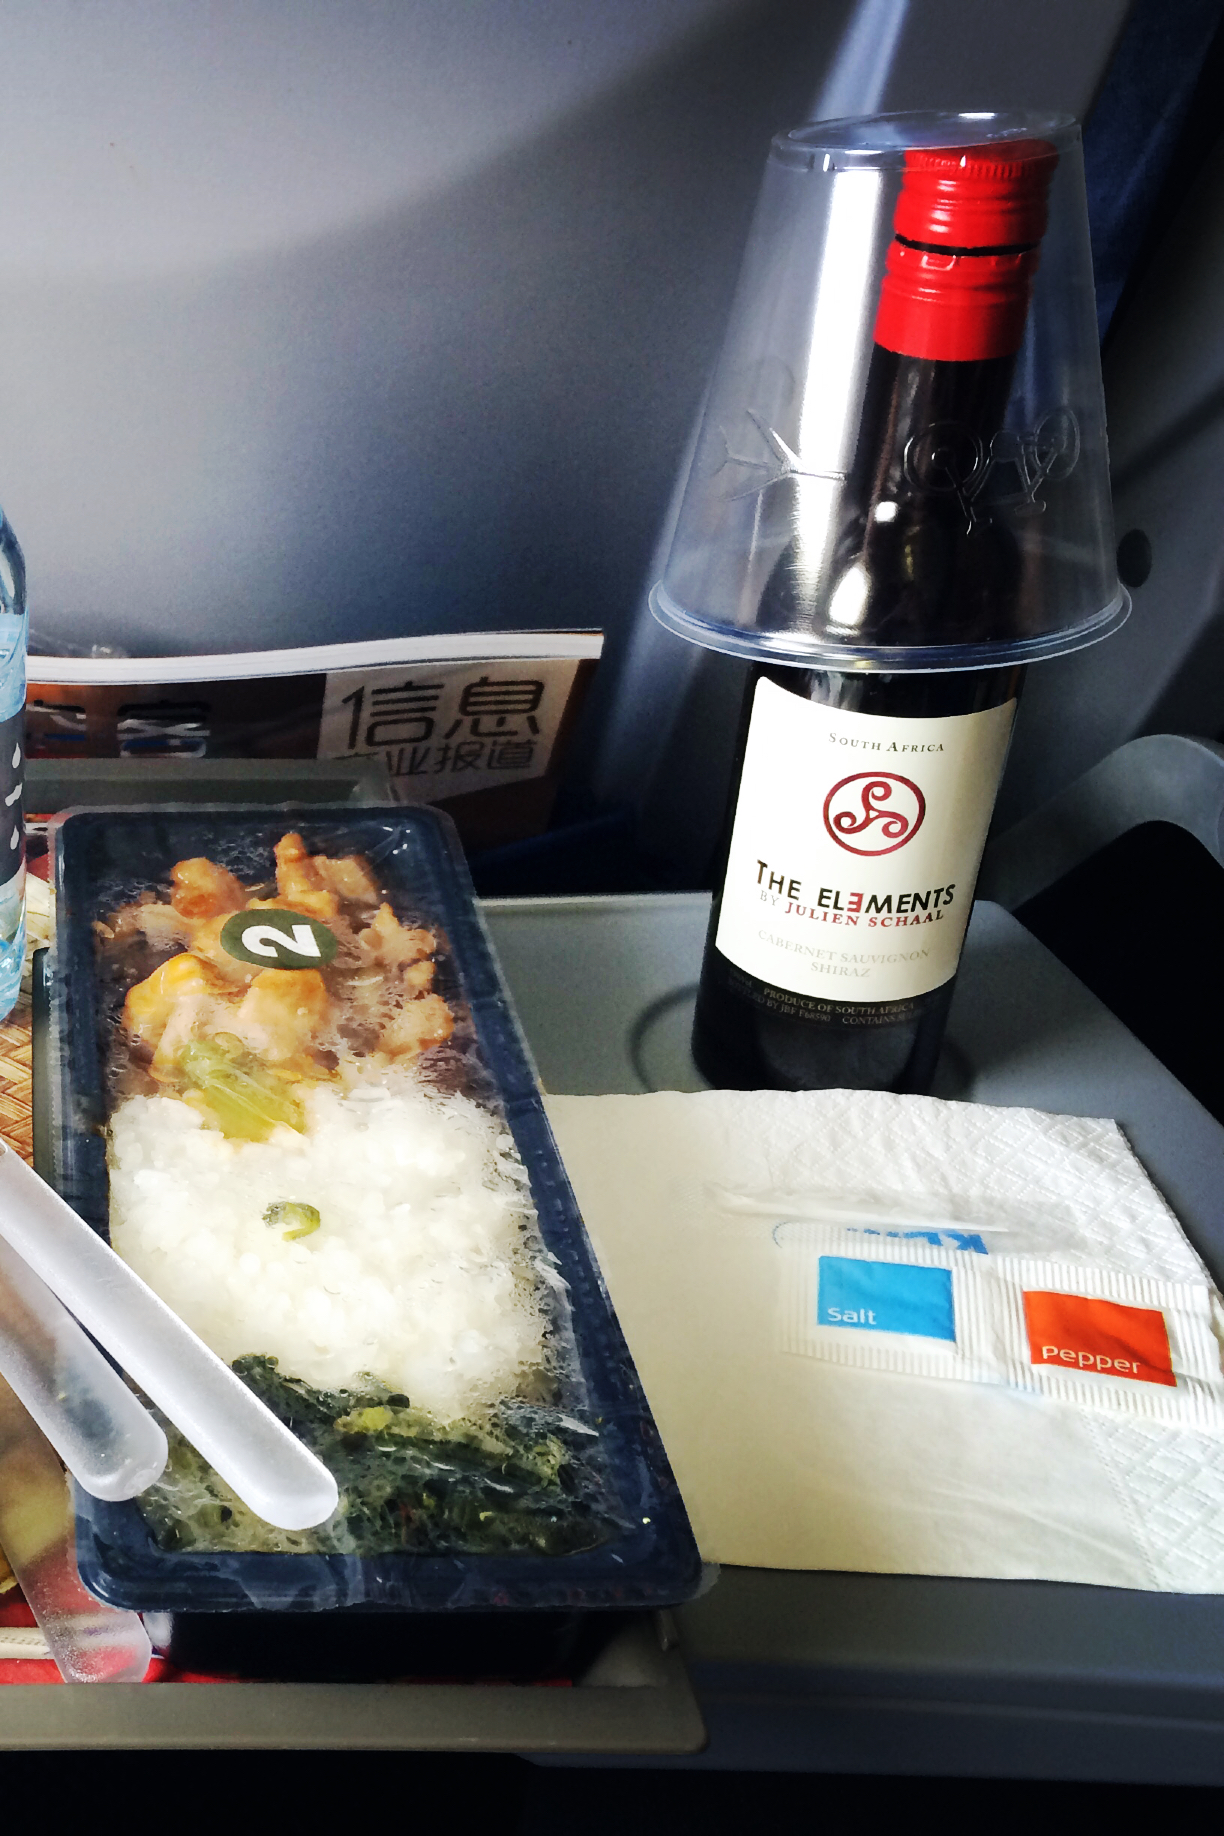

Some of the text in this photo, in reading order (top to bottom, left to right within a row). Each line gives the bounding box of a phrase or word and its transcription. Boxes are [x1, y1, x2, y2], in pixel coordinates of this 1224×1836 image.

[342, 676, 545, 750] 信息
[828, 732, 945, 753] SOUTH AFRICA
[756, 858, 803, 901] THE
[759, 889, 945, 928] BY JULIEN SCHAAL
[241, 924, 322, 958] 2
[757, 929, 932, 965] CABERNET SAUVIGNON
[810, 961, 872, 979] SHIRAZ
[763, 987, 816, 1013] PRODUCE
[817, 1002, 835, 1014] OF
[835, 1005, 877, 1017] SOUTH
[827, 1305, 877, 1326] Salt
